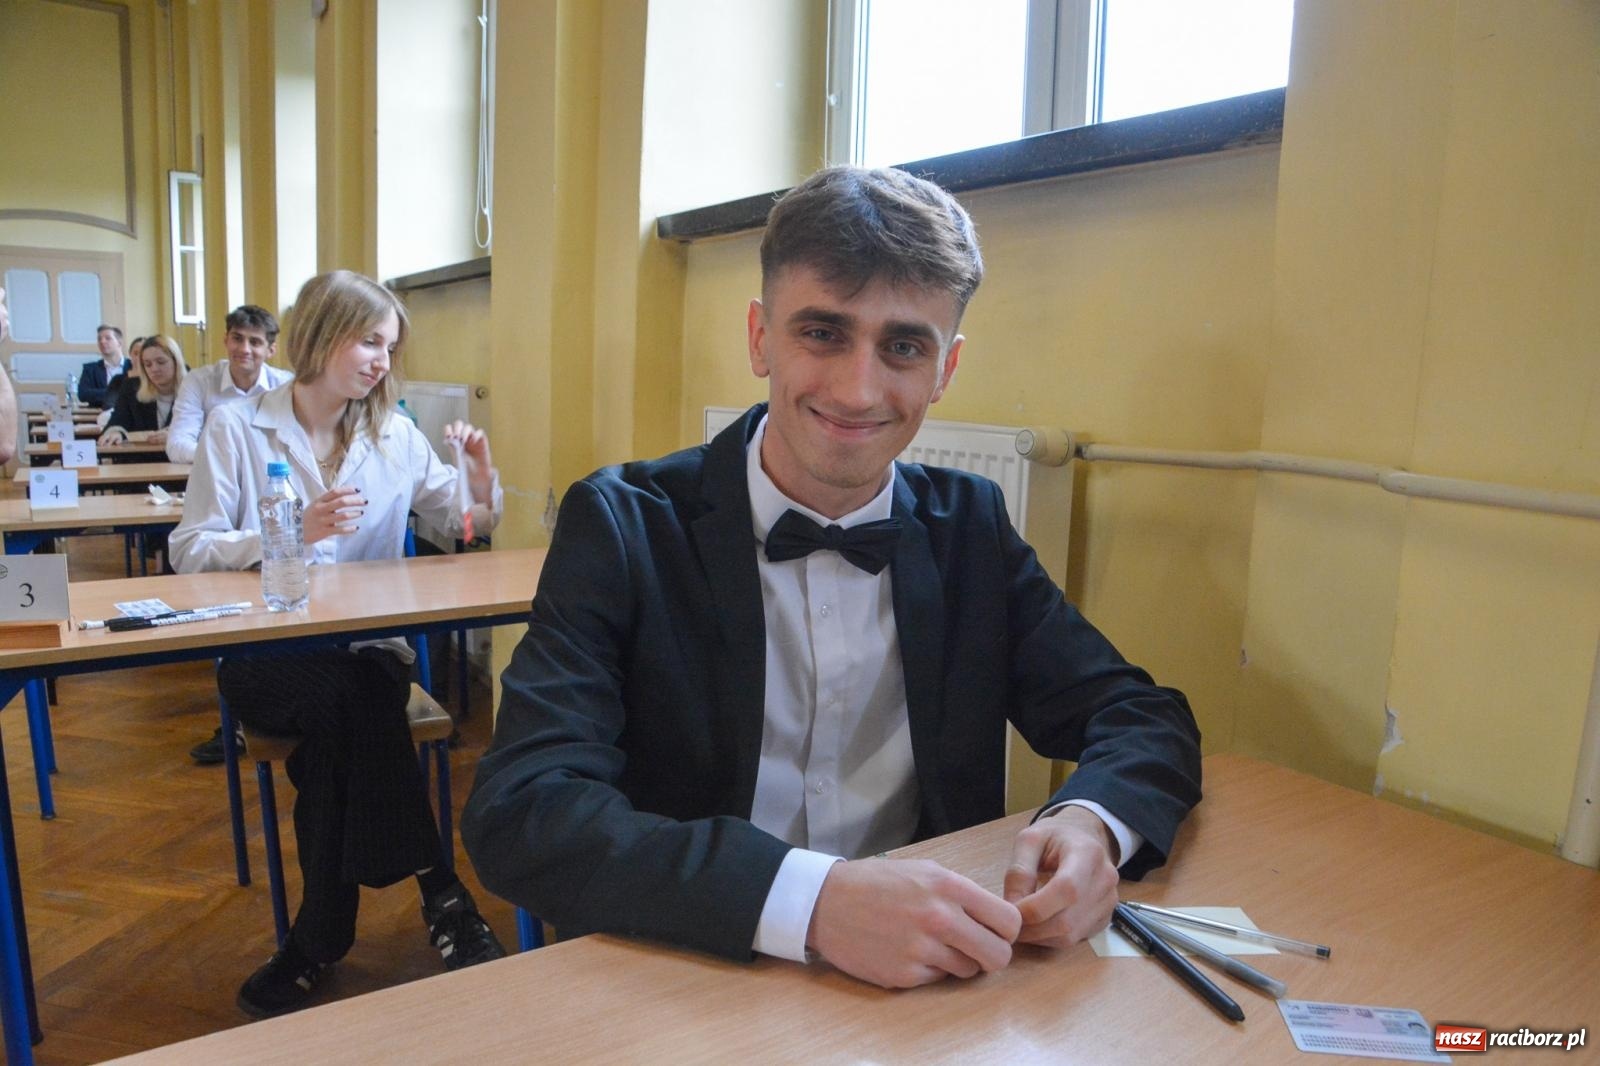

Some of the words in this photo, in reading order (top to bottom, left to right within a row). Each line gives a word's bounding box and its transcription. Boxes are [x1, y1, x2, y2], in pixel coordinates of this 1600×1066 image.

[58, 429, 65, 438] 6
[76, 451, 84, 462] 5
[49, 484, 60, 499] 4
[19, 582, 35, 608] 3
